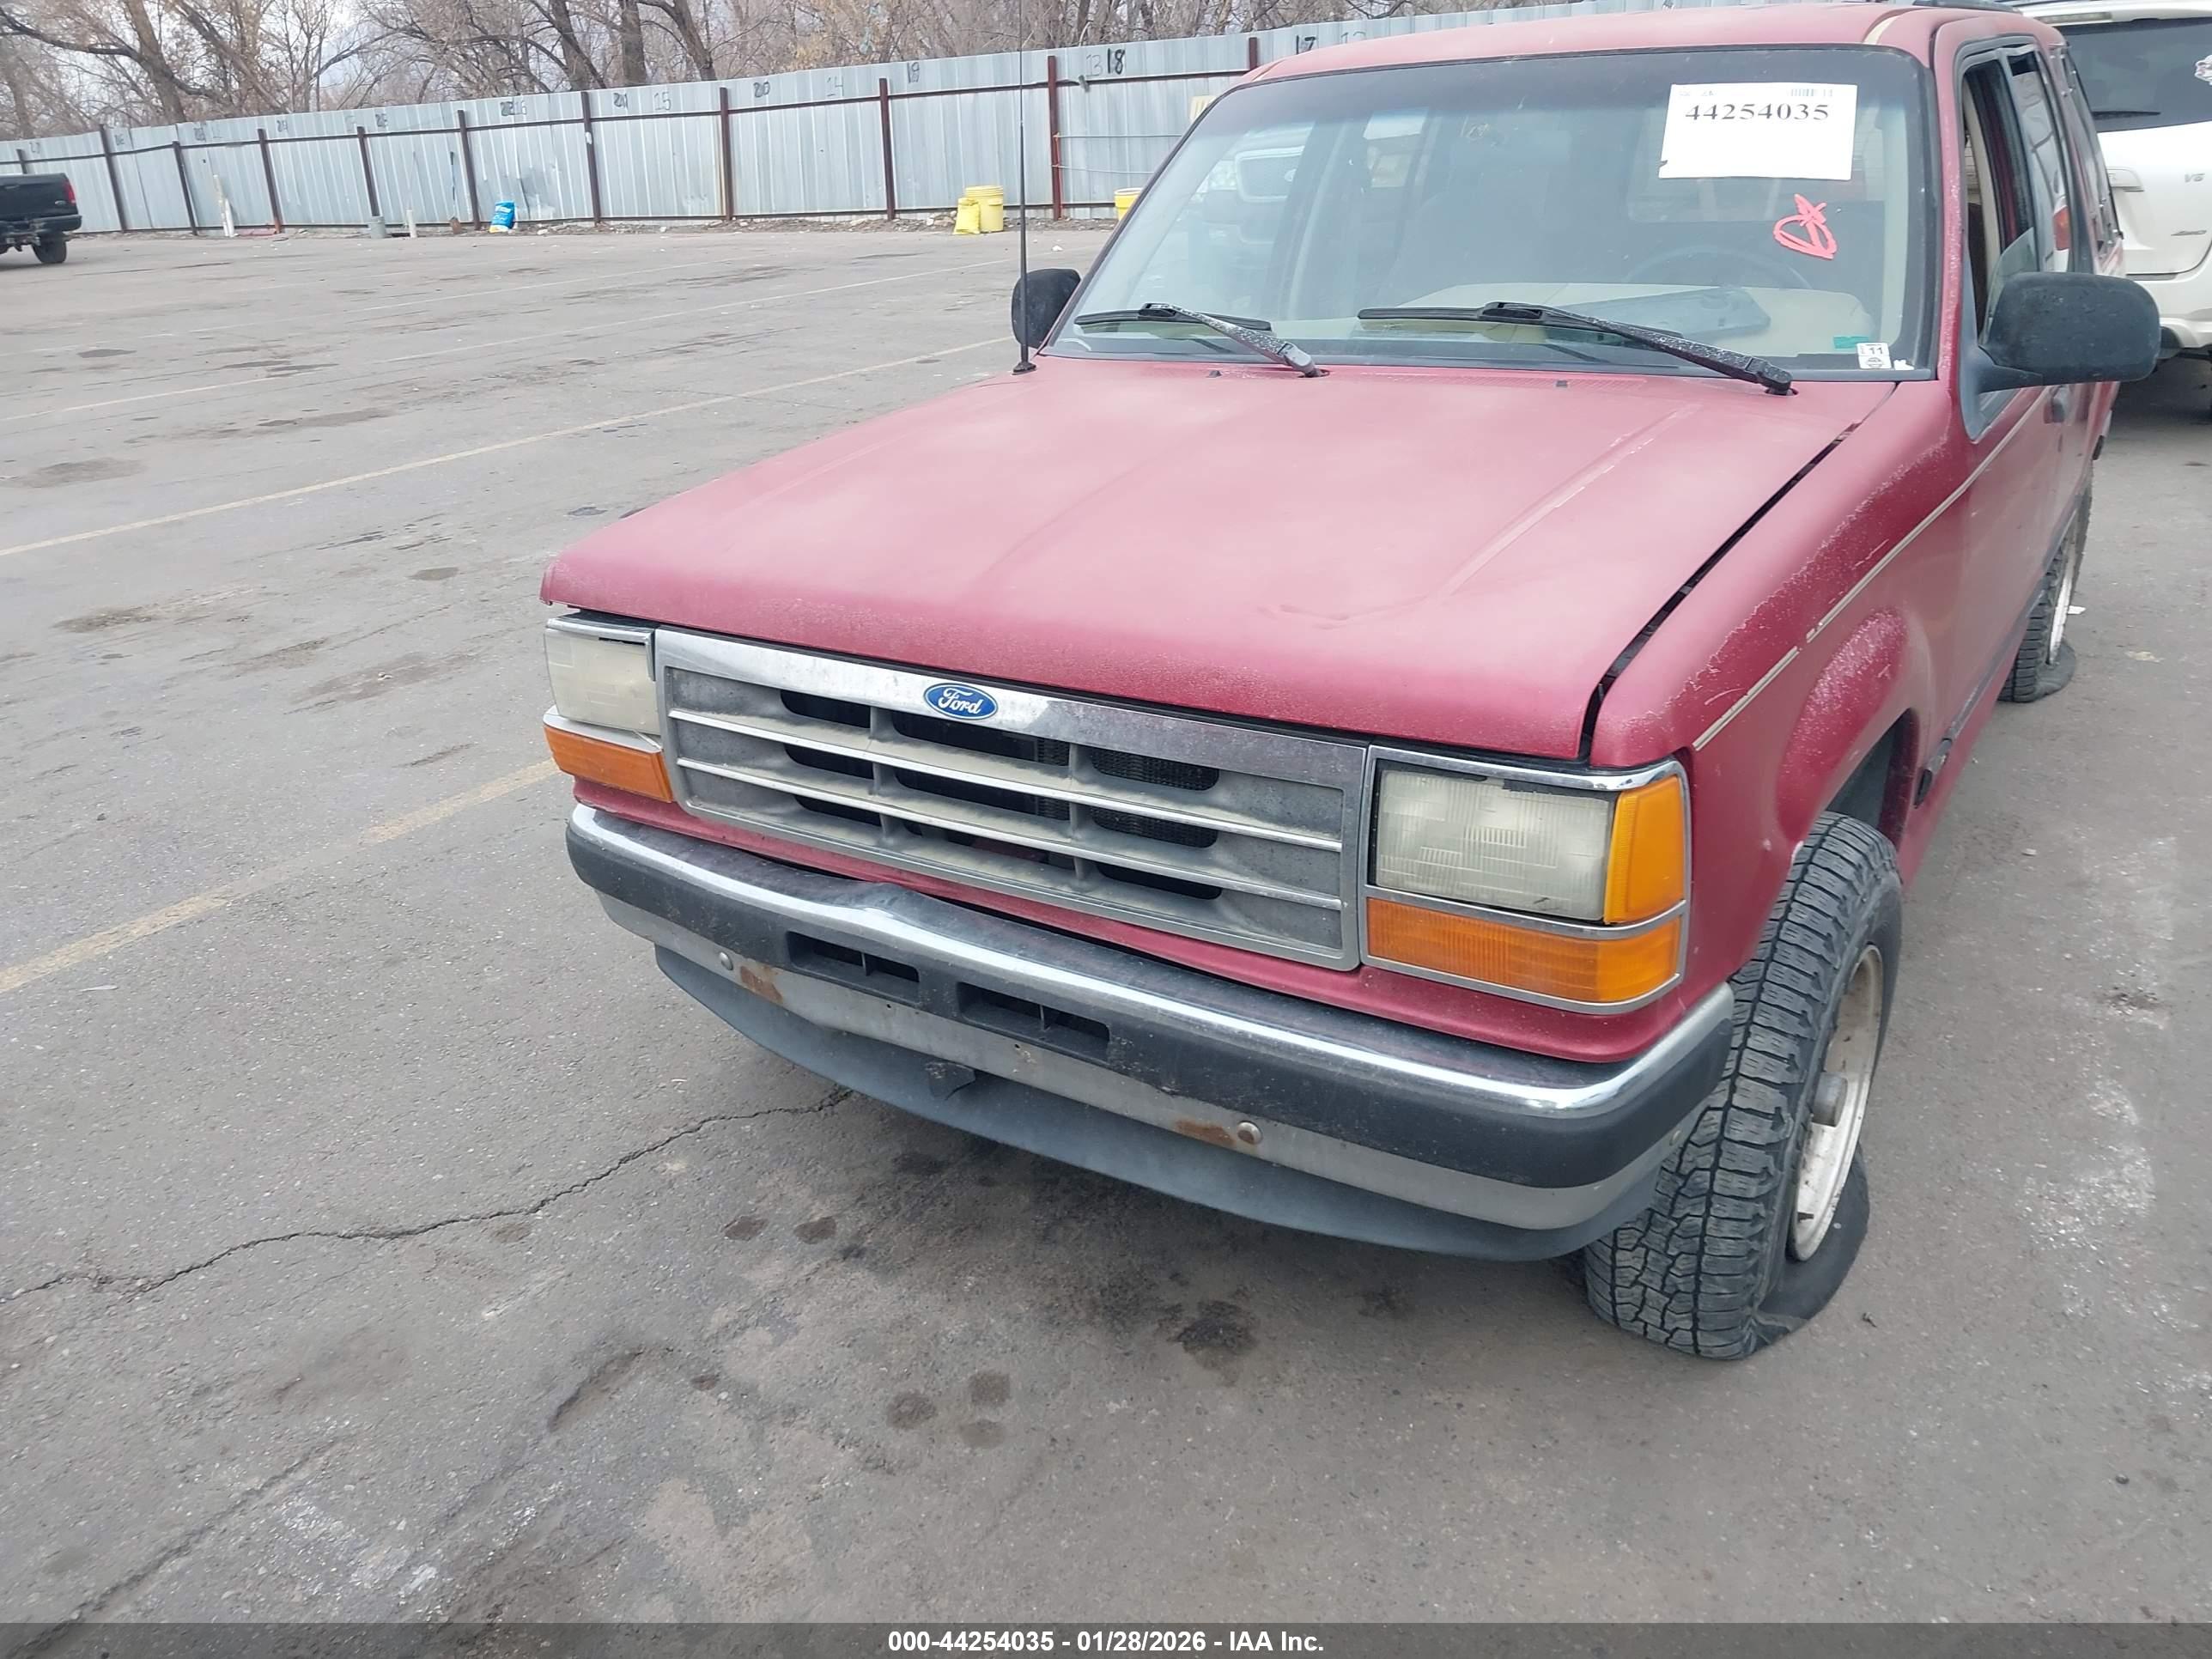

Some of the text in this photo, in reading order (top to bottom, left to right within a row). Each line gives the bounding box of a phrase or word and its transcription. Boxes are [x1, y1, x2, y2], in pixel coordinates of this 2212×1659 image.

[1296, 35, 1316, 55] 17
[1108, 48, 1125, 75] 18
[653, 91, 672, 111] 15
[1685, 103, 1829, 120] 44254035
[938, 688, 984, 714] Ford
